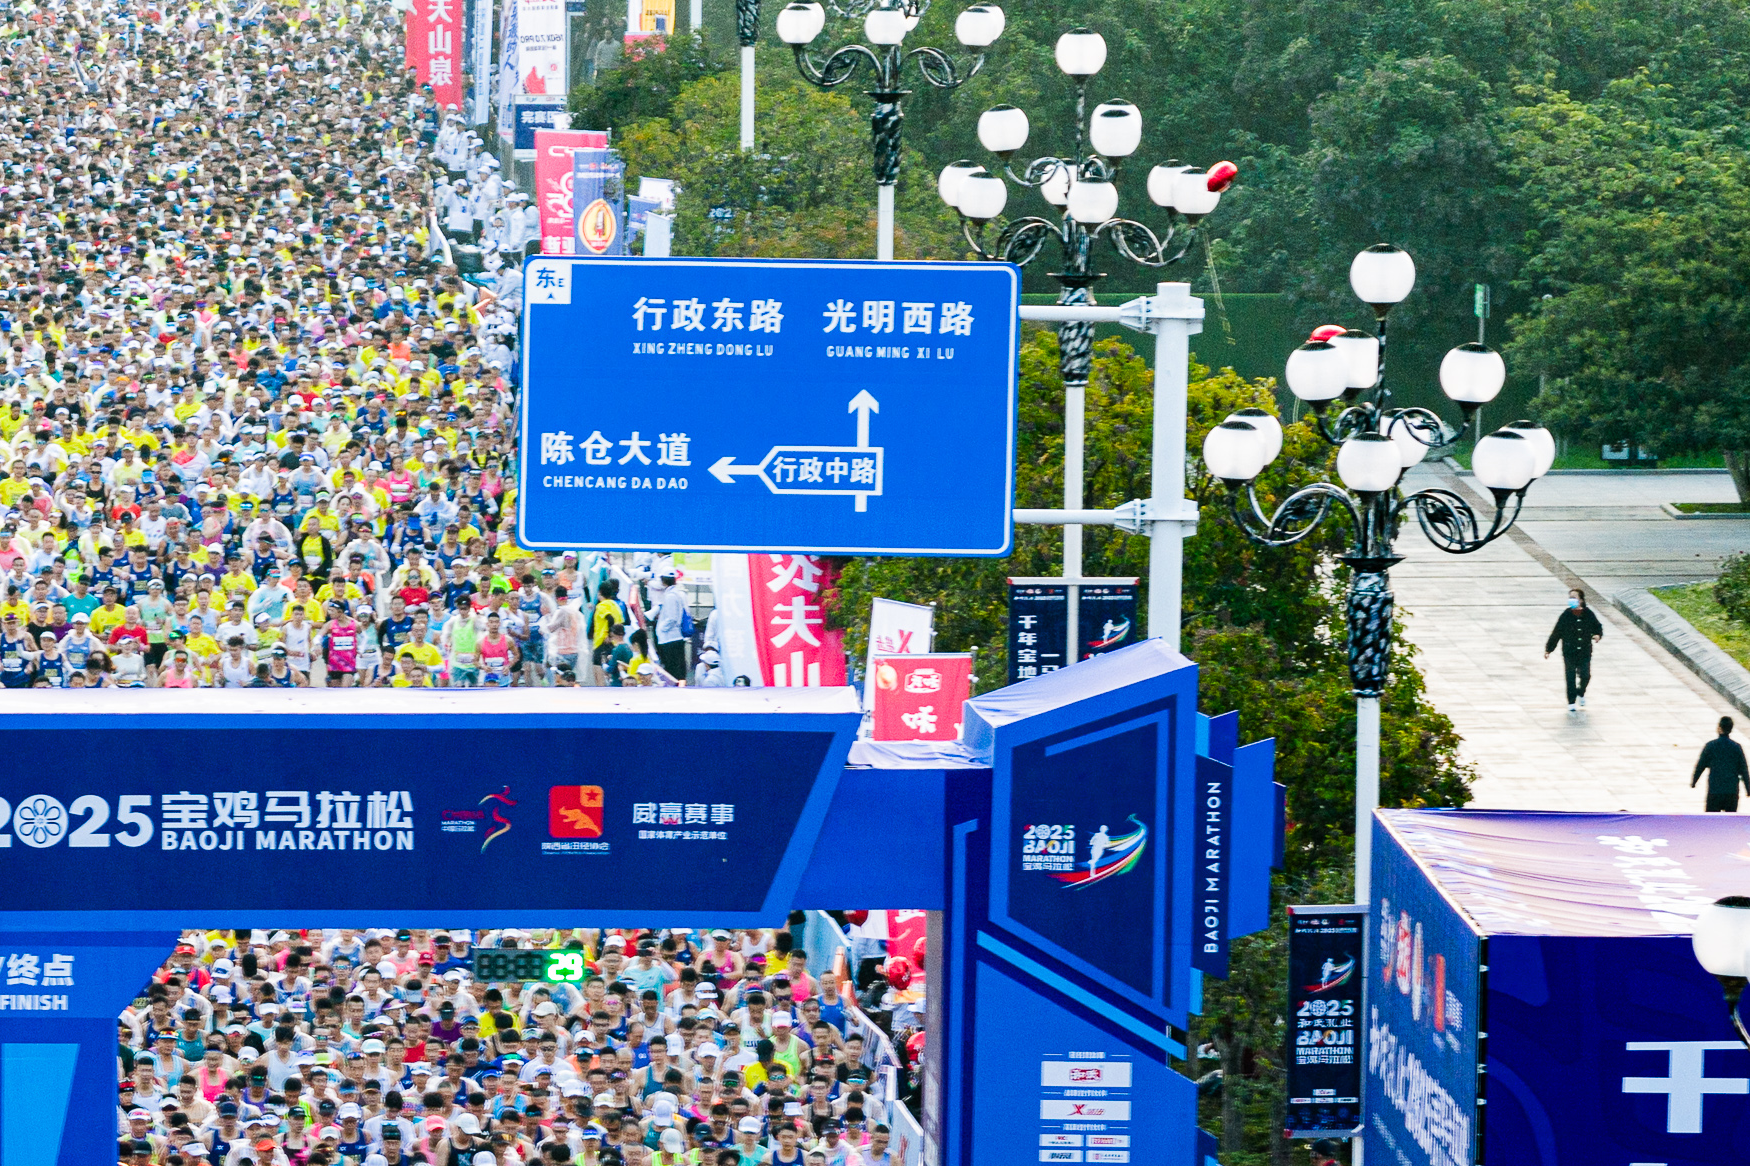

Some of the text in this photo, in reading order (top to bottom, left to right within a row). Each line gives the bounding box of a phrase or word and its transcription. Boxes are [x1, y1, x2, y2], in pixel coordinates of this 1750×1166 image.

[536, 268, 556, 288] 东
[558, 278, 564, 287] E
[632, 297, 784, 333] 行政东路
[822, 299, 974, 335] 光明西路
[633, 342, 773, 356] XING ZHENG DONG LU
[827, 346, 954, 359] GUANG MING XI LU
[541, 432, 692, 466] 陈仓大道
[773, 457, 876, 484] 行政中路
[543, 476, 688, 490] CHENCANG DA DAO
[1017, 615, 1037, 678] 千年宝地
[162, 790, 415, 830] 宝鸡马拉松
[162, 831, 415, 851] BAOJI MARATHON
[1023, 824, 1074, 839] 2025
[1023, 840, 1074, 854] BAOJI
[1204, 782, 1221, 953] BAOJI MARATHON
[548, 953, 583, 981] 29
[1297, 1000, 1354, 1017] 2025
[1296, 1030, 1354, 1045] BAOJI
[1296, 1047, 1354, 1055] MARATHON
